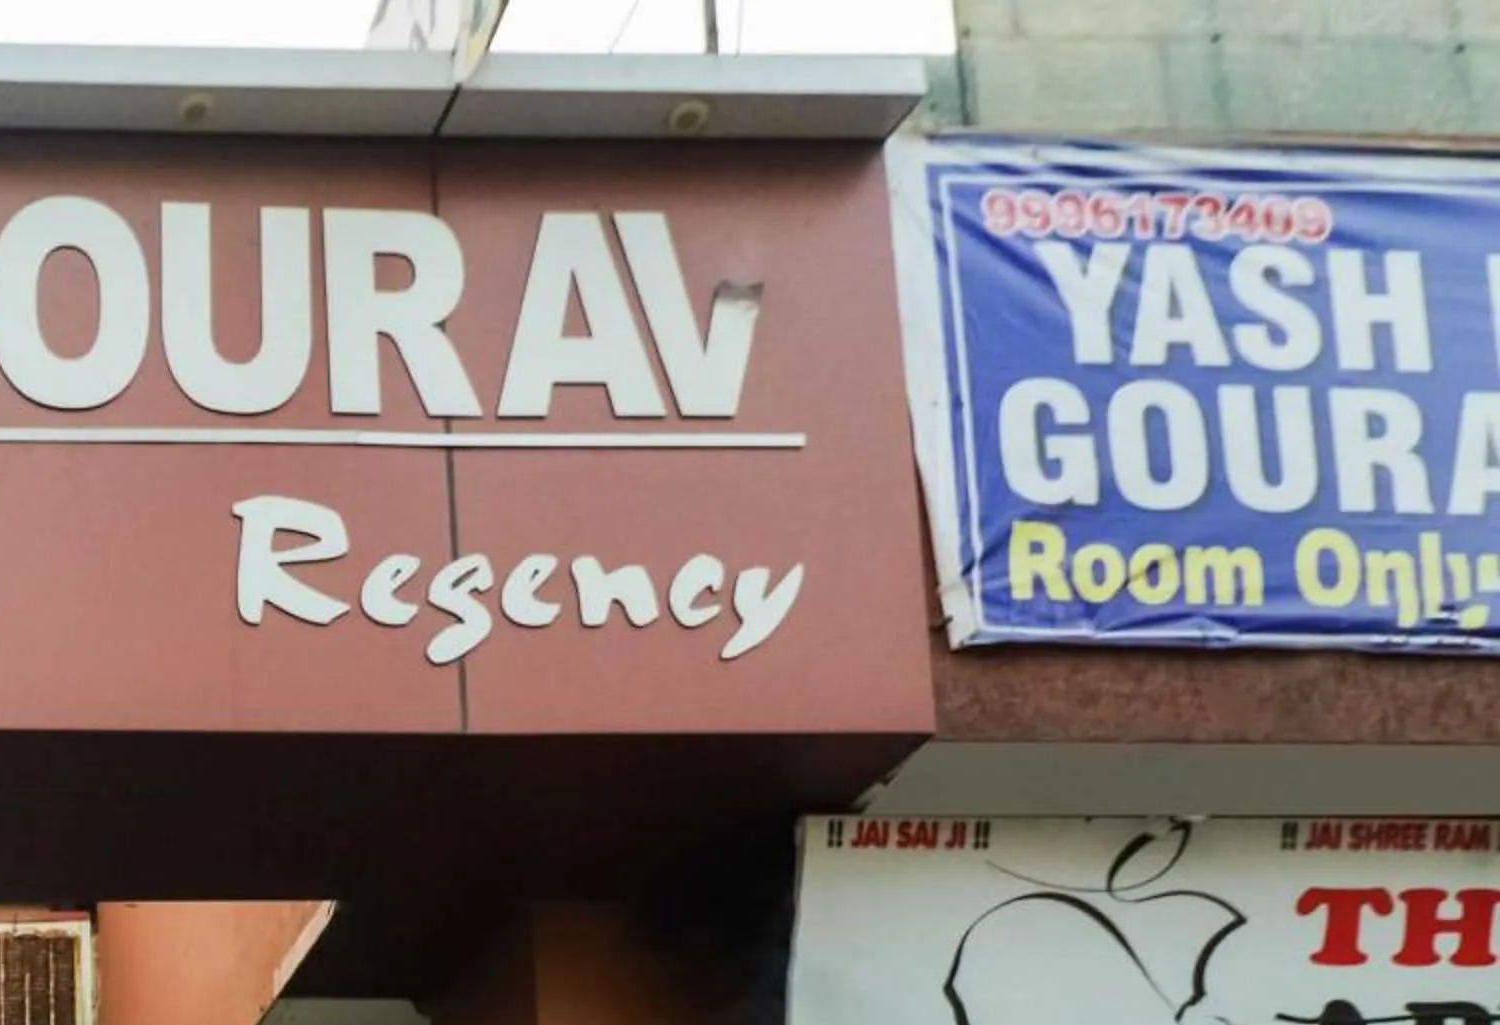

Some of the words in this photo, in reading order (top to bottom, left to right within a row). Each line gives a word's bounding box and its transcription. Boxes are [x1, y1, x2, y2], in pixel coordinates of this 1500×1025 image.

[1033, 241, 1434, 373] YASH
[232, 494, 804, 665] Regency
[1008, 519, 1265, 608] Room
[852, 819, 890, 849] JAI
[896, 820, 940, 849] SAI
[945, 820, 967, 849] JI
[1305, 821, 1343, 850] JAI
[1348, 821, 1429, 850] SHREE
[1434, 822, 1491, 851] RAM
